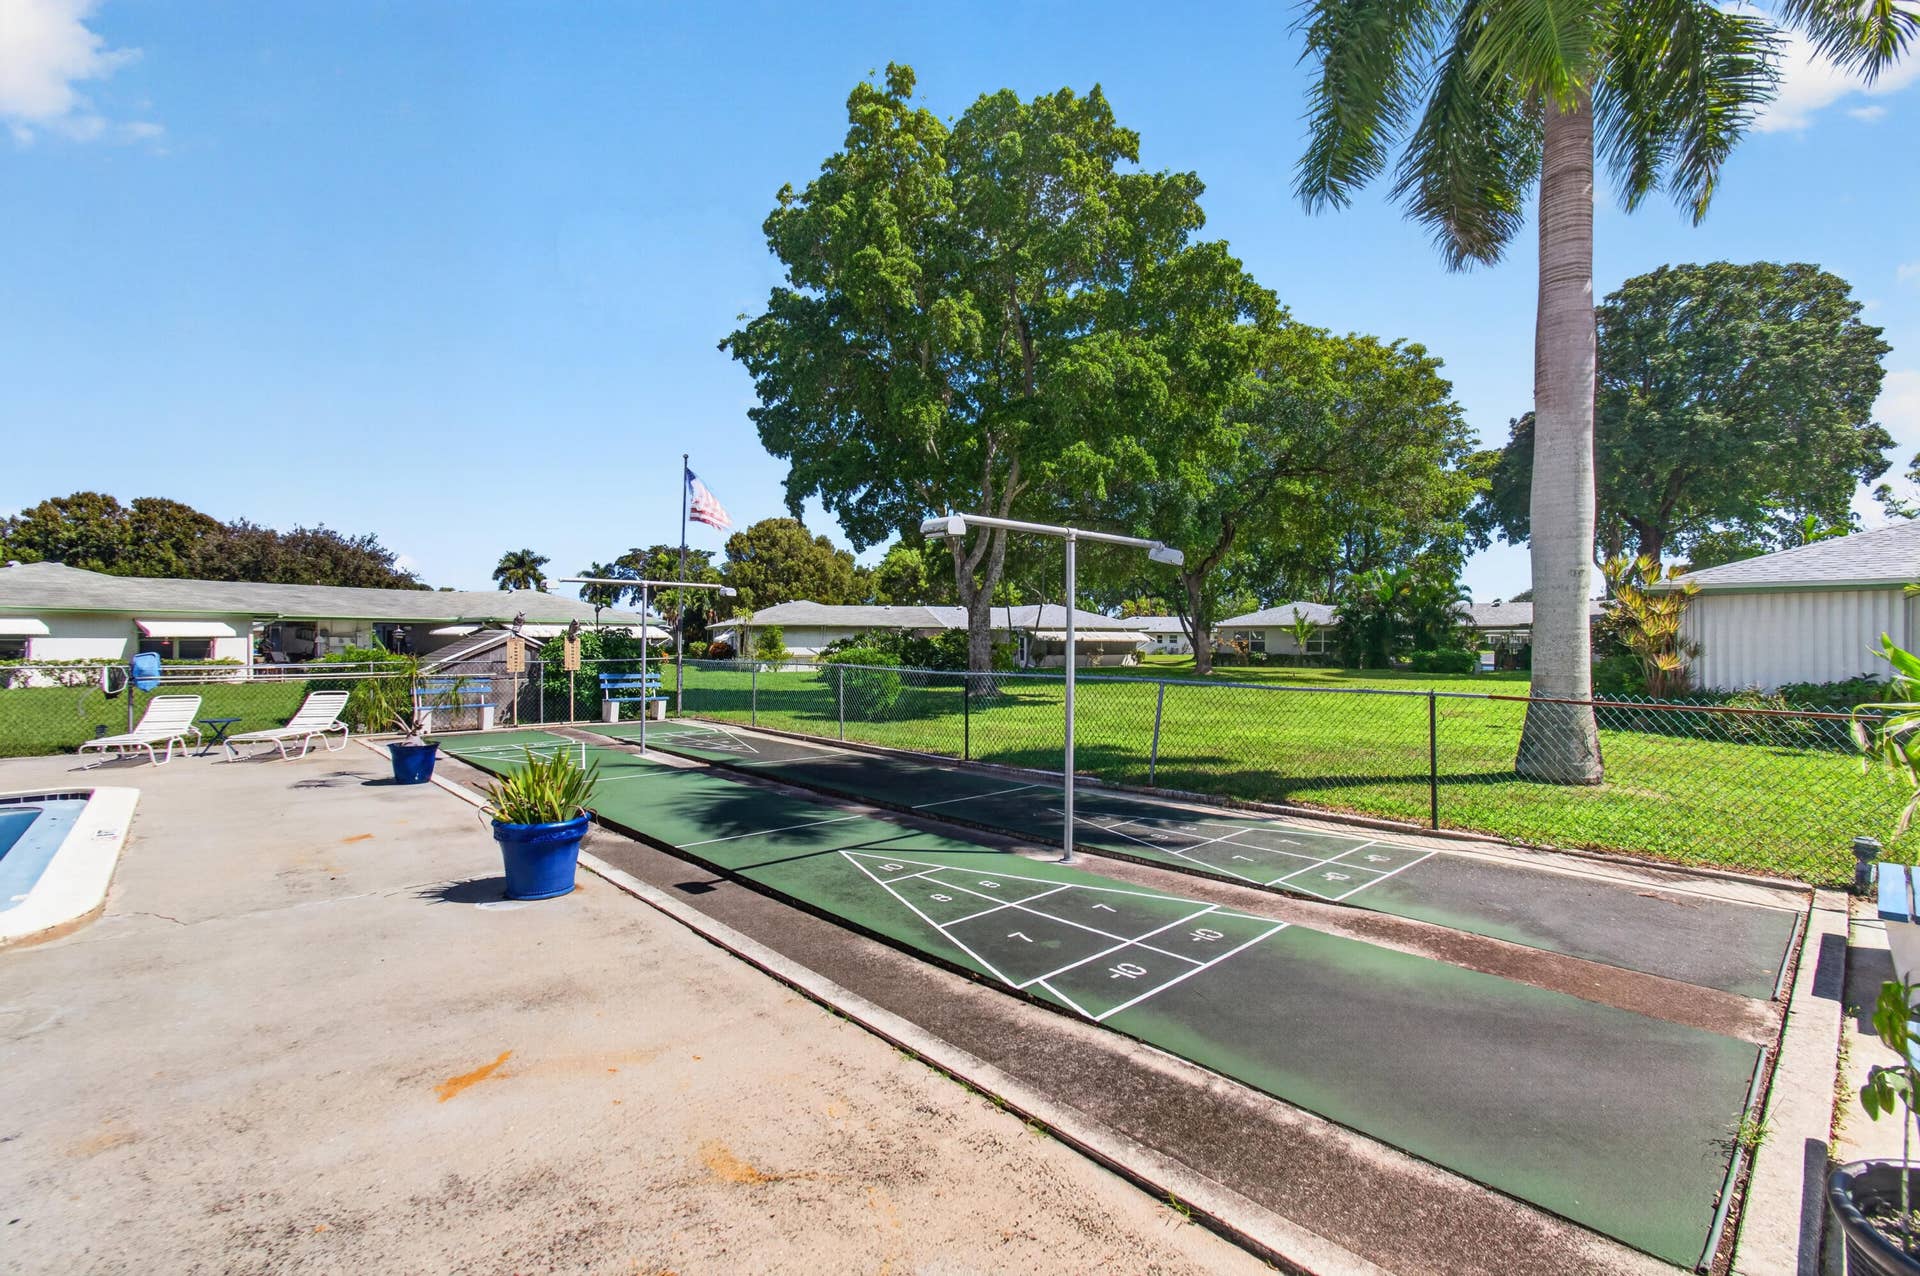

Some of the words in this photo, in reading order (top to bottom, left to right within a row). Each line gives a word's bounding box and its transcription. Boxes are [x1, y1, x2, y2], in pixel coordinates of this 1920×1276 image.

[1231, 854, 1254, 862] 7
[878, 863, 904, 872] 10
[978, 880, 1000, 888] 8
[930, 893, 953, 902] 8
[1092, 903, 1117, 912] 7
[1007, 931, 1033, 943] 7
